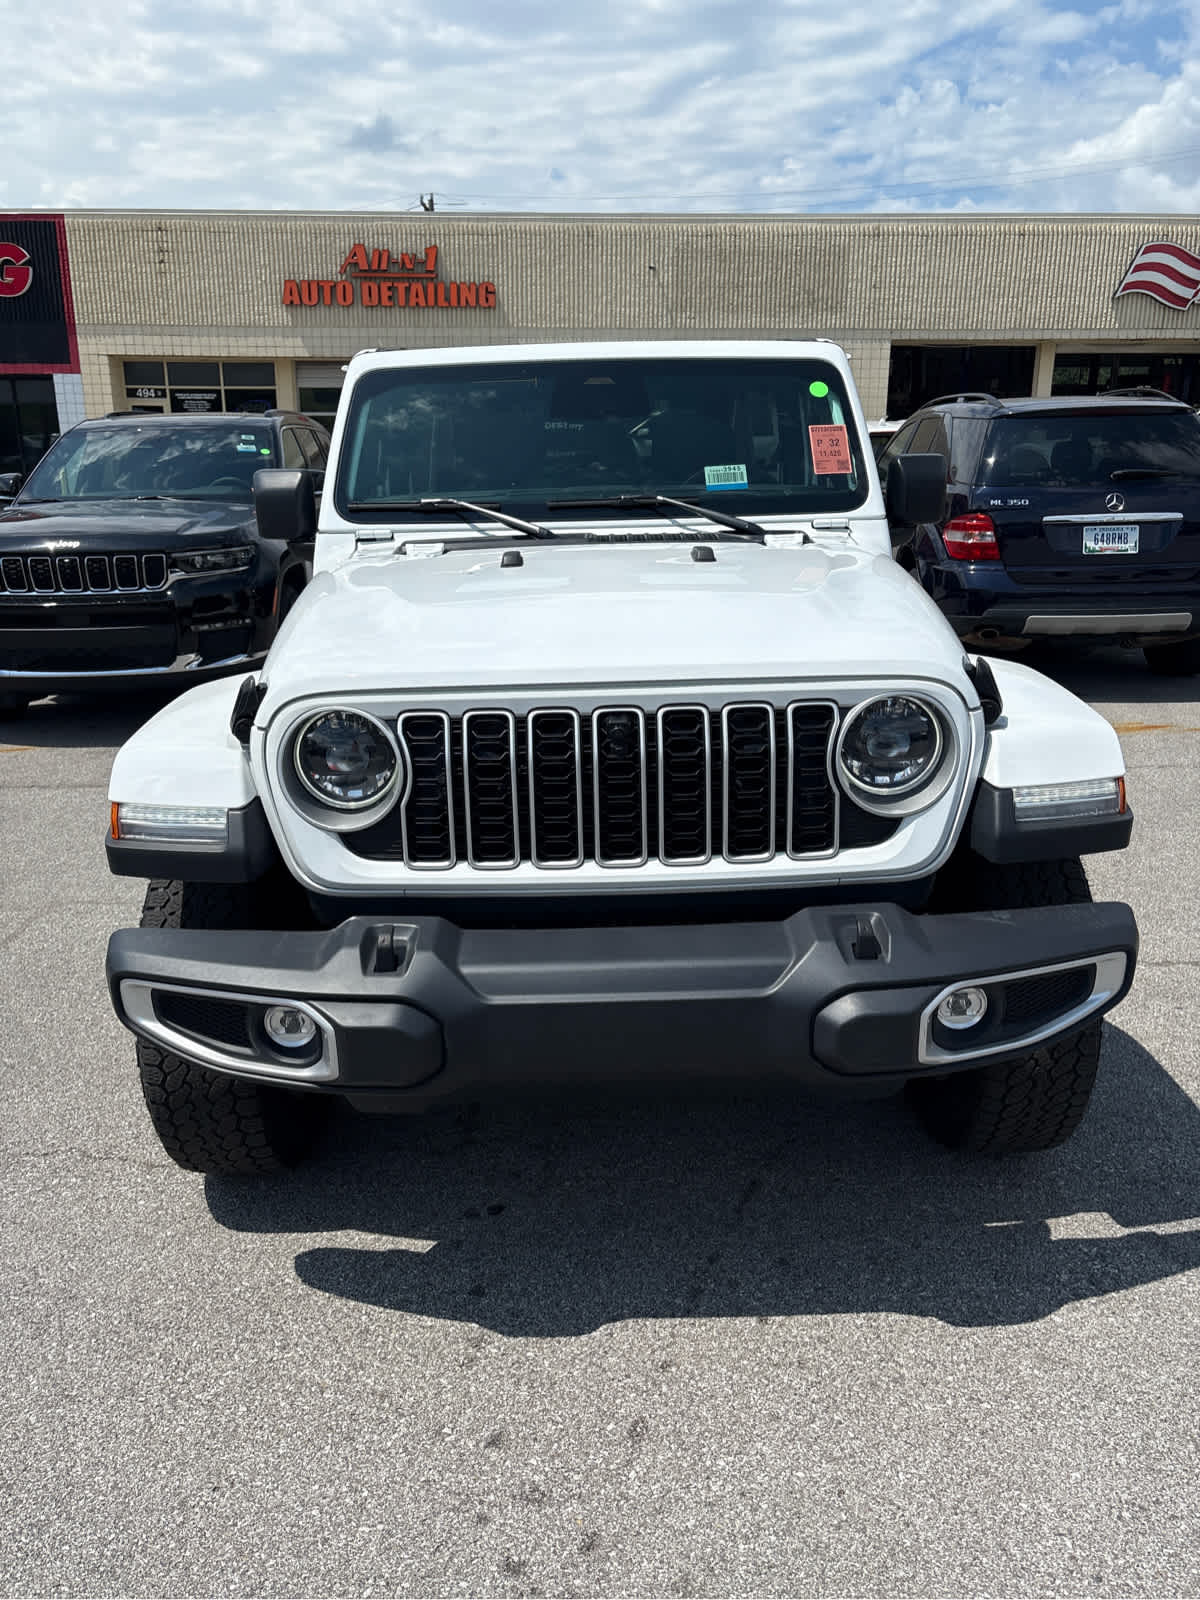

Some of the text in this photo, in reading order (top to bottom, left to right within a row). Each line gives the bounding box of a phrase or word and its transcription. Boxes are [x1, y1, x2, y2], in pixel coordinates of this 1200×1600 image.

[282, 279, 496, 308] AUTO DETAILING
[136, 388, 156, 398] 494
[816, 439, 840, 447] P 32
[56, 540, 80, 549] Jeep
